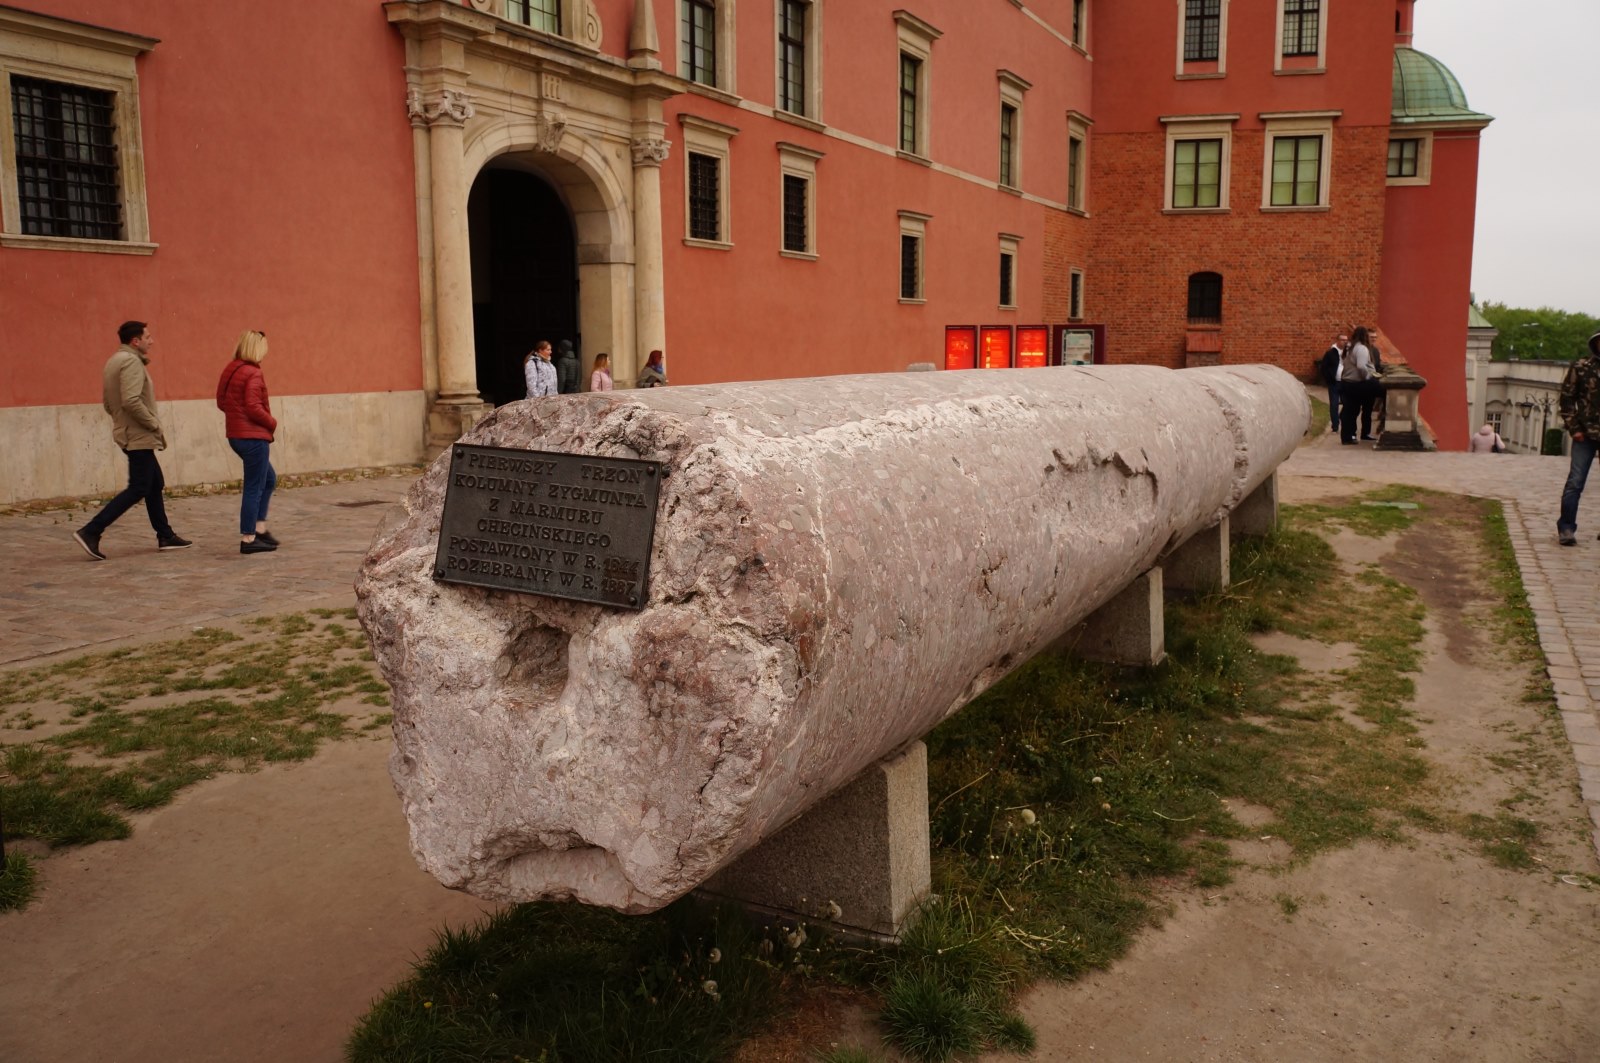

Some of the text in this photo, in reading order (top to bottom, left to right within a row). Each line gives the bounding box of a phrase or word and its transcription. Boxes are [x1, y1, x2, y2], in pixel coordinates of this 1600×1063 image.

[469, 453, 643, 484] PIERWSZY TRZON
[454, 473, 647, 509] KOLUMNY ZYGMUNTA
[489, 498, 604, 525] Z MARMURU
[449, 536, 556, 562] POSTAWIONY
[562, 551, 579, 566] W
[584, 554, 601, 570] R.
[447, 556, 552, 582] ROZEBRANY
[560, 571, 576, 586] W
[582, 575, 598, 590] R.
